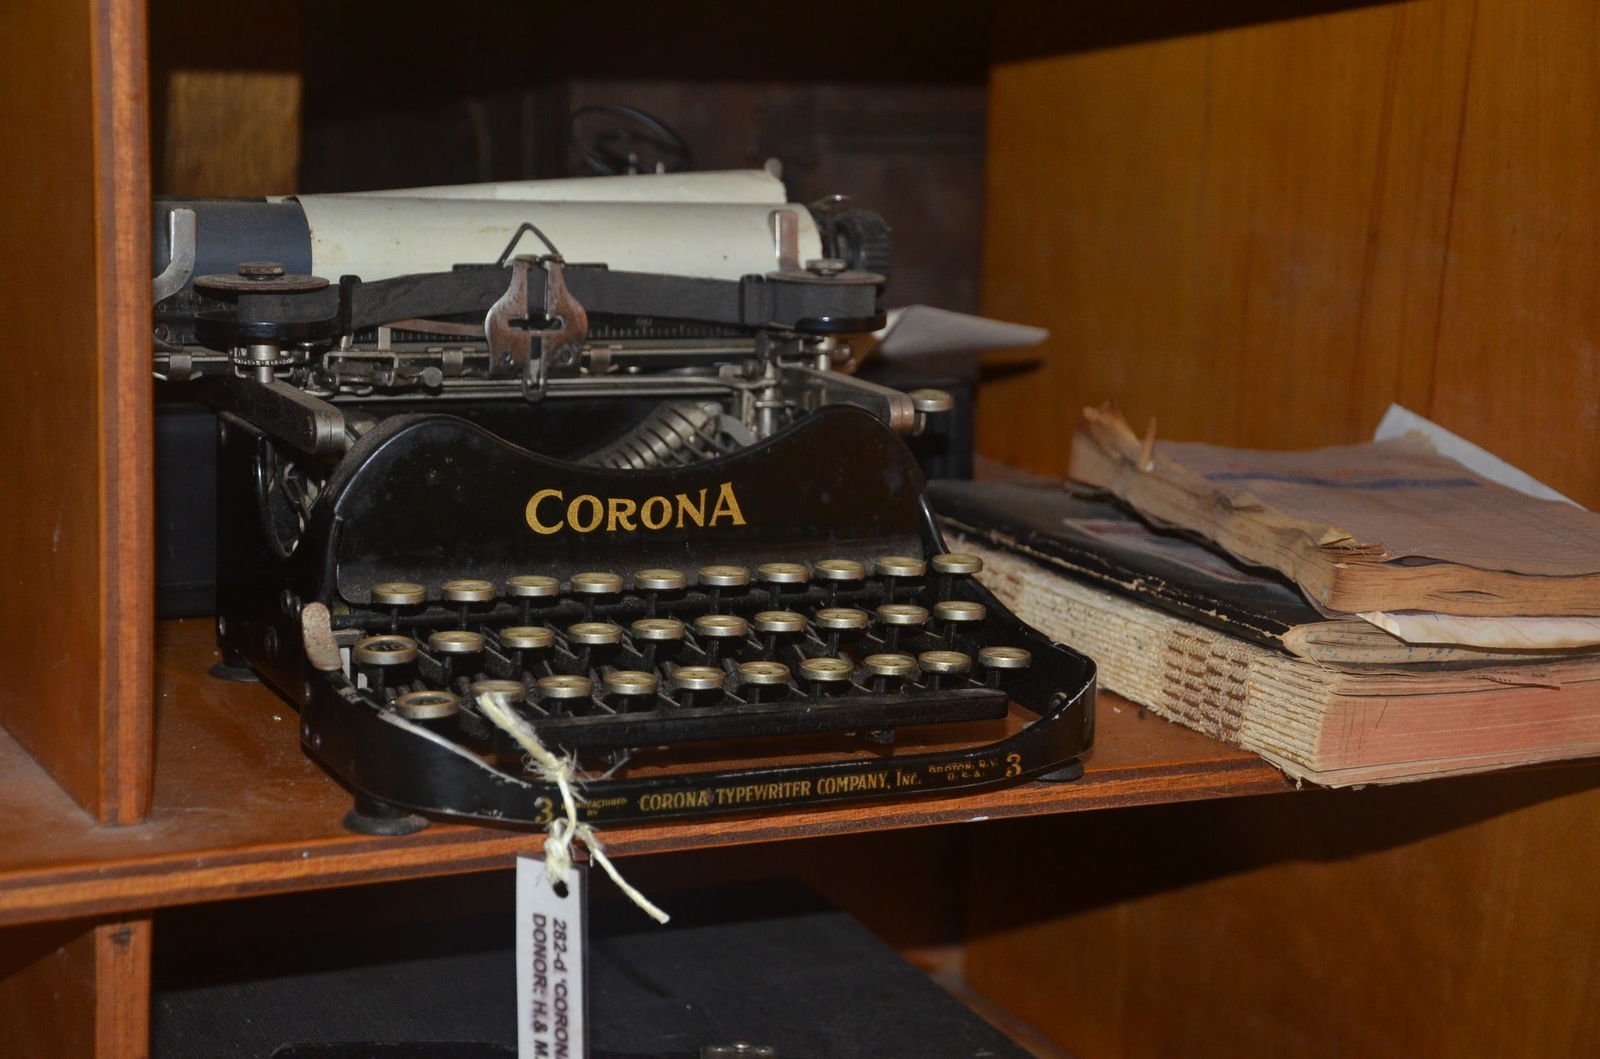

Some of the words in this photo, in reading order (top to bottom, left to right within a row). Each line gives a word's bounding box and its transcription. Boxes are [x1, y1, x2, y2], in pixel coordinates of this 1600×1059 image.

[525, 481, 747, 535] CORONA
[1006, 752, 1023, 778] 3
[534, 795, 554, 823] 3
[640, 791, 709, 811] CORONA
[716, 781, 811, 804] TYPEWRITER
[817, 774, 891, 794] COMPANY,
[532, 912, 548, 994] DONOR:
[553, 917, 567, 973] 282-d
[553, 979, 569, 1059] ‘CORON
